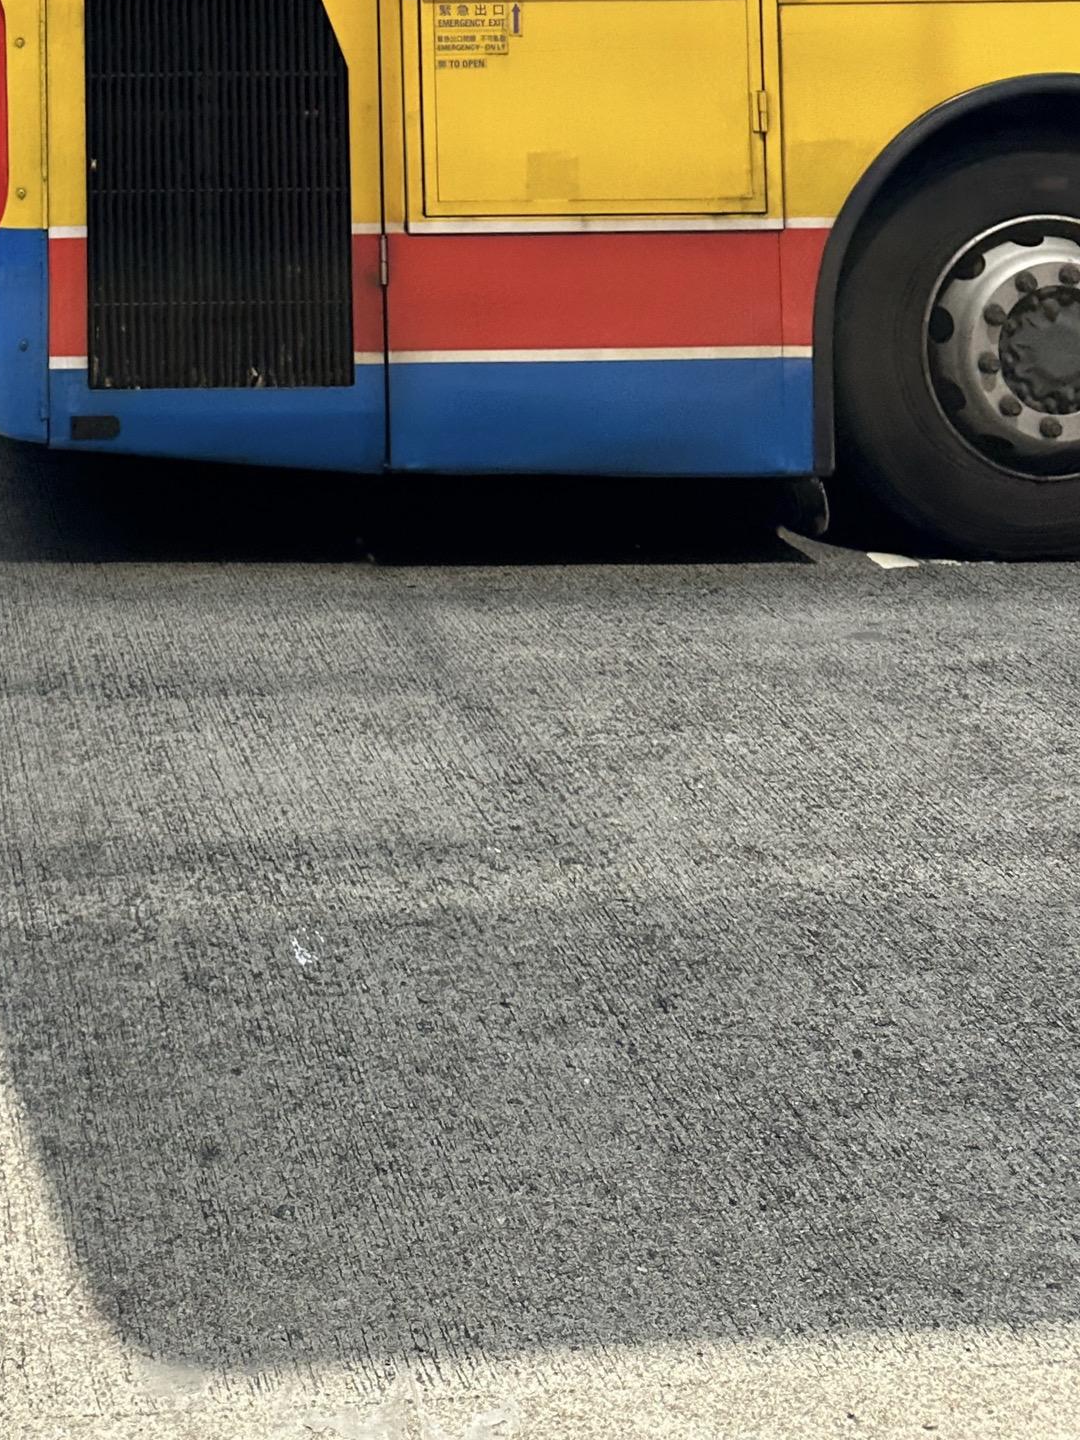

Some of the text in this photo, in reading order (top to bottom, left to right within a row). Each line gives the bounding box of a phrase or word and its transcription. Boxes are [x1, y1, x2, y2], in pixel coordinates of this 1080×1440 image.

[437, 18, 505, 28] EMERGENCY EXIT
[449, 60, 460, 69] TO
[462, 59, 485, 69] OPEN
